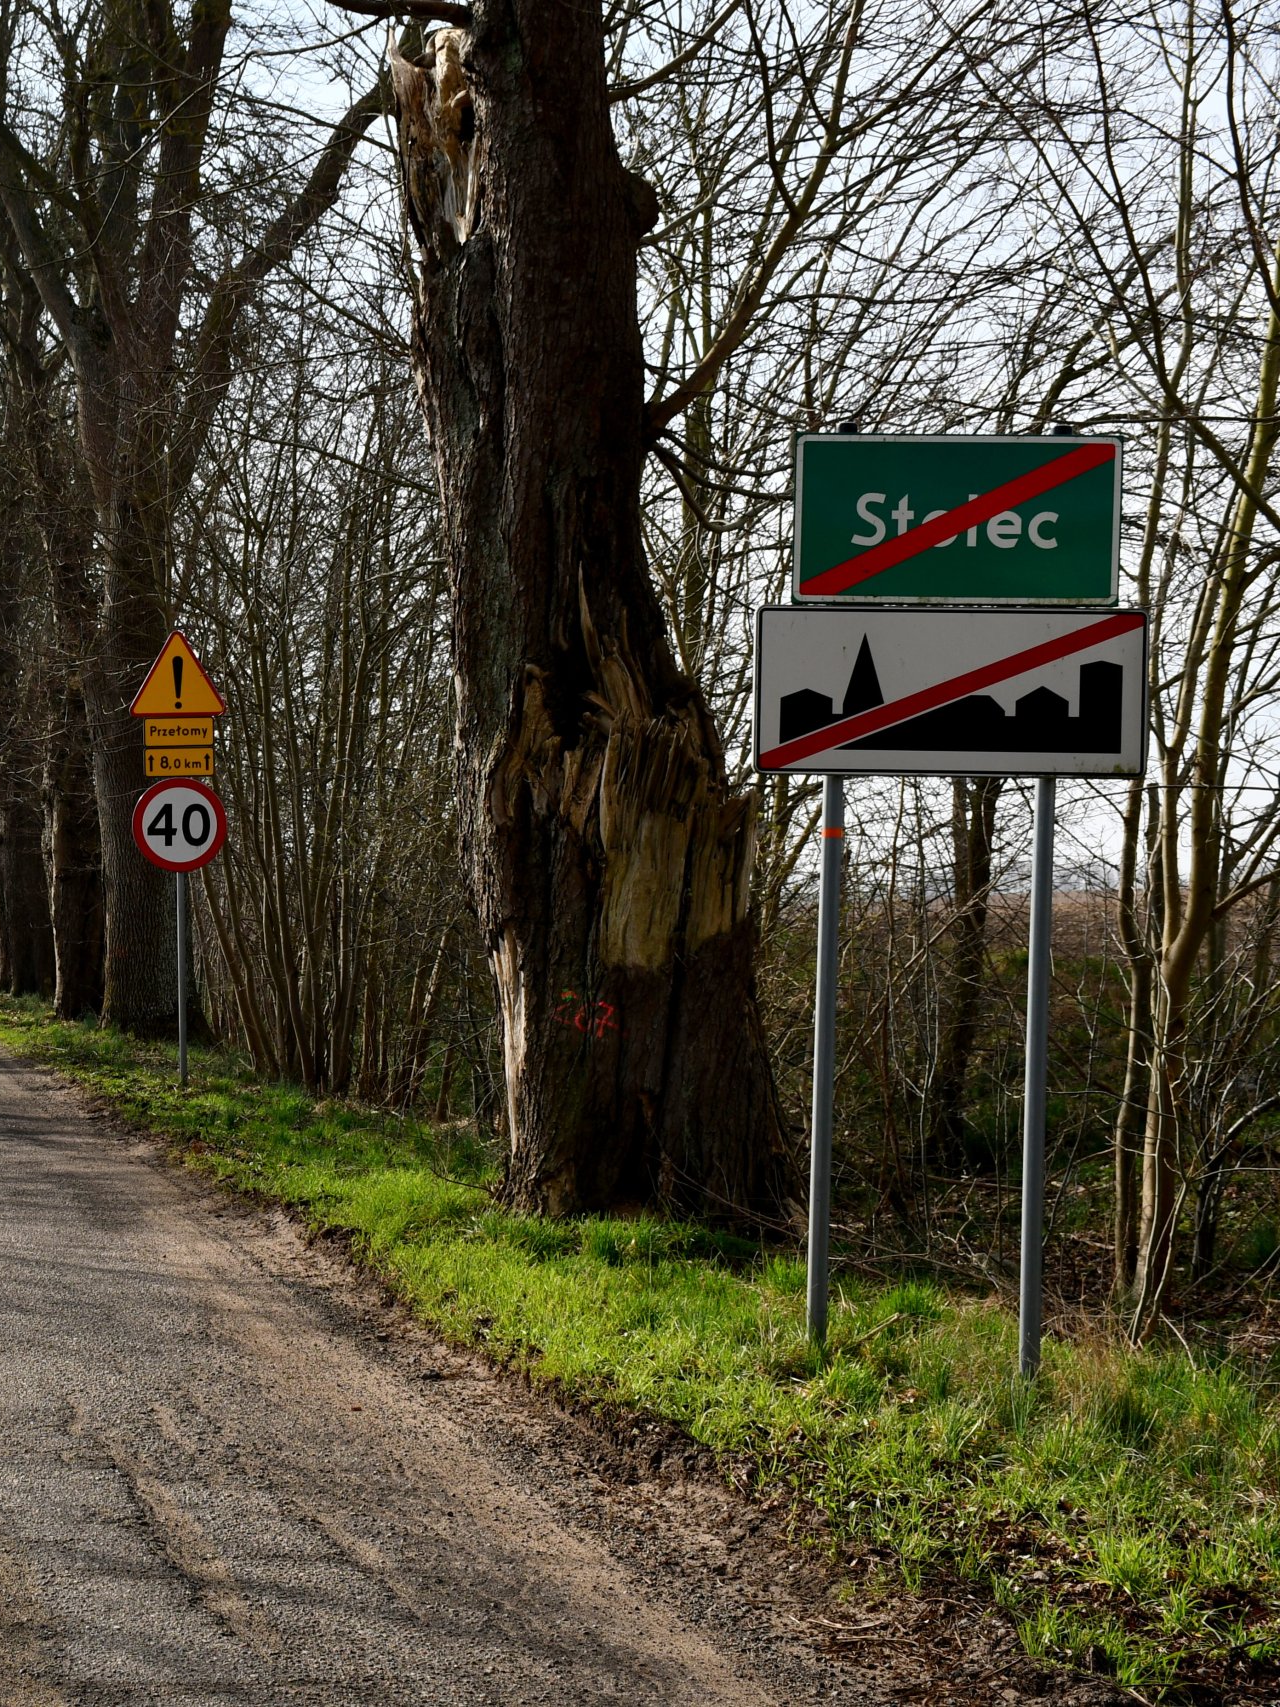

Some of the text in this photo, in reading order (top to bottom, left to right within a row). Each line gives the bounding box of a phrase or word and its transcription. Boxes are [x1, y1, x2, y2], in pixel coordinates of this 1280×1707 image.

[851, 492, 1059, 549] Stolec
[149, 725, 208, 739] Przełomy
[159, 756, 202, 771] 8,0 km
[147, 803, 211, 847] 40
